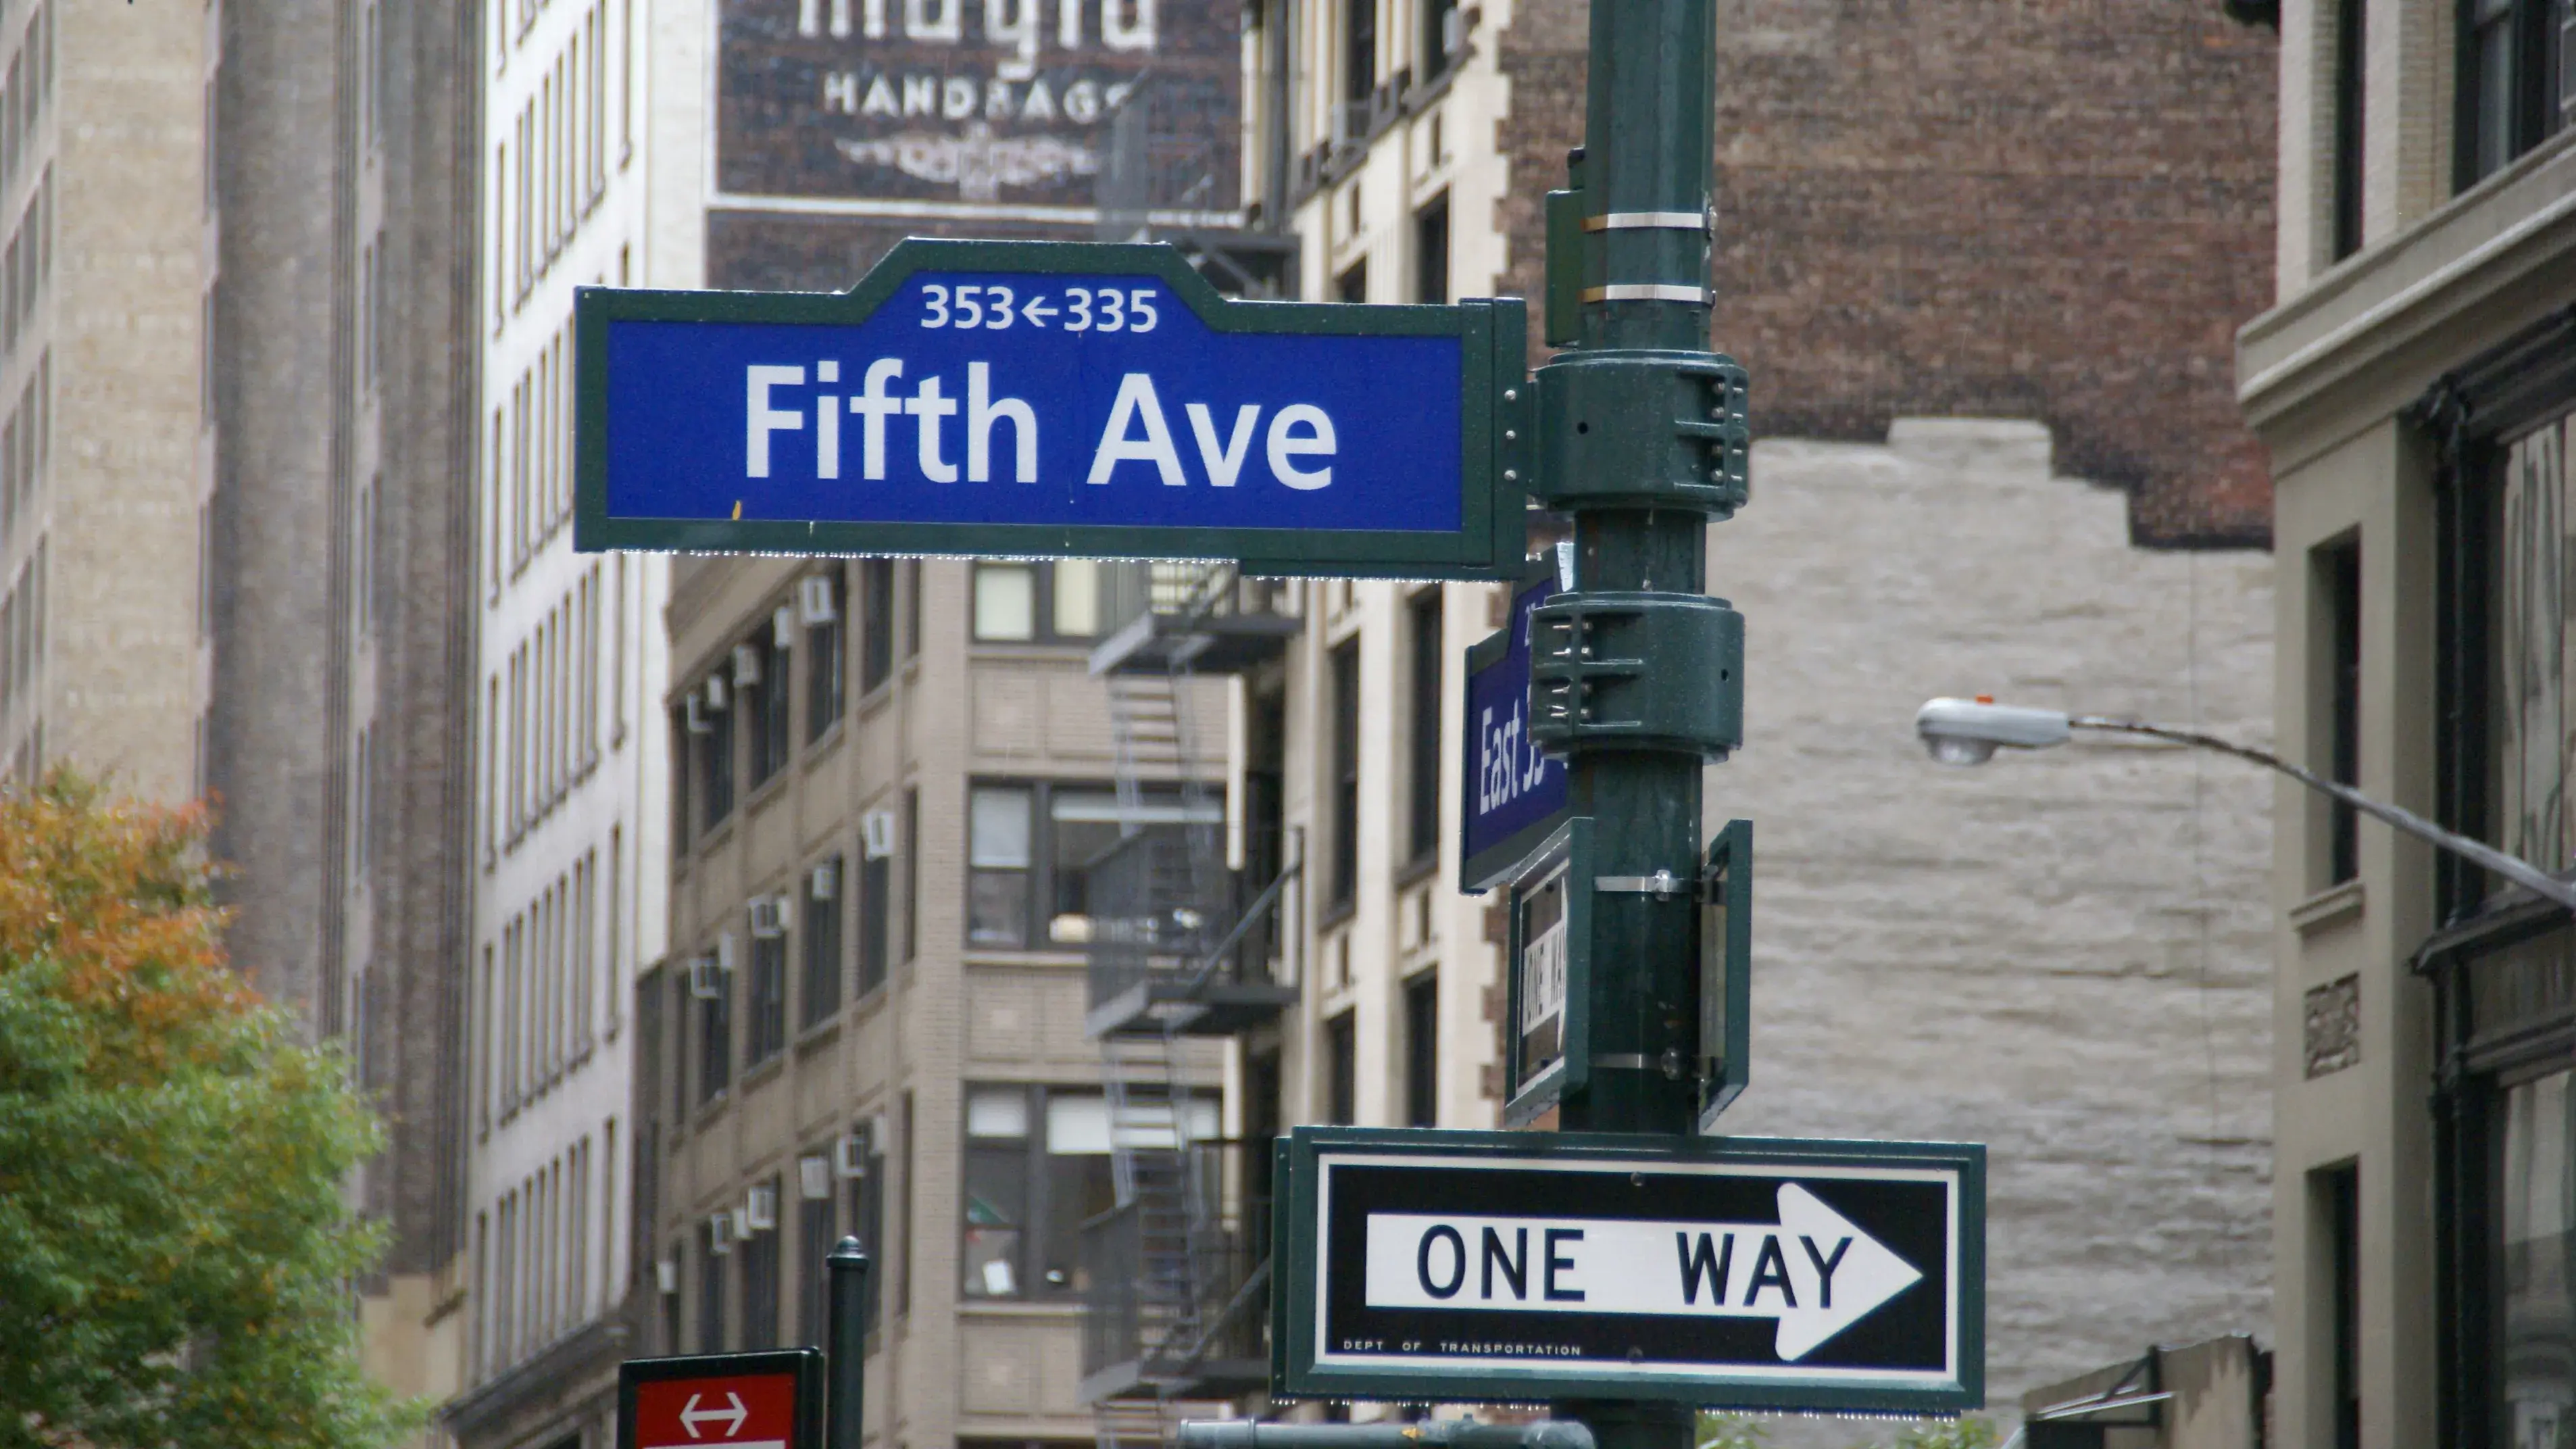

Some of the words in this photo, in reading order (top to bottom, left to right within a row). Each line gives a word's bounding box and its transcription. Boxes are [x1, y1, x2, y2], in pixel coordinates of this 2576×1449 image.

[920, 284, 1014, 330] 353
[1063, 287, 1158, 334] 335
[745, 358, 1038, 484] Fifth
[1086, 372, 1337, 491] Ave
[1479, 699, 1520, 816] East
[1550, 926, 1565, 1006] WA
[1416, 1223, 1586, 1302] ONE
[1675, 1231, 1854, 1310] WAY
[1343, 1340, 1383, 1350] DEPT
[1402, 1342, 1421, 1351] OF
[1439, 1342, 1581, 1356] TRANSPORTATION
